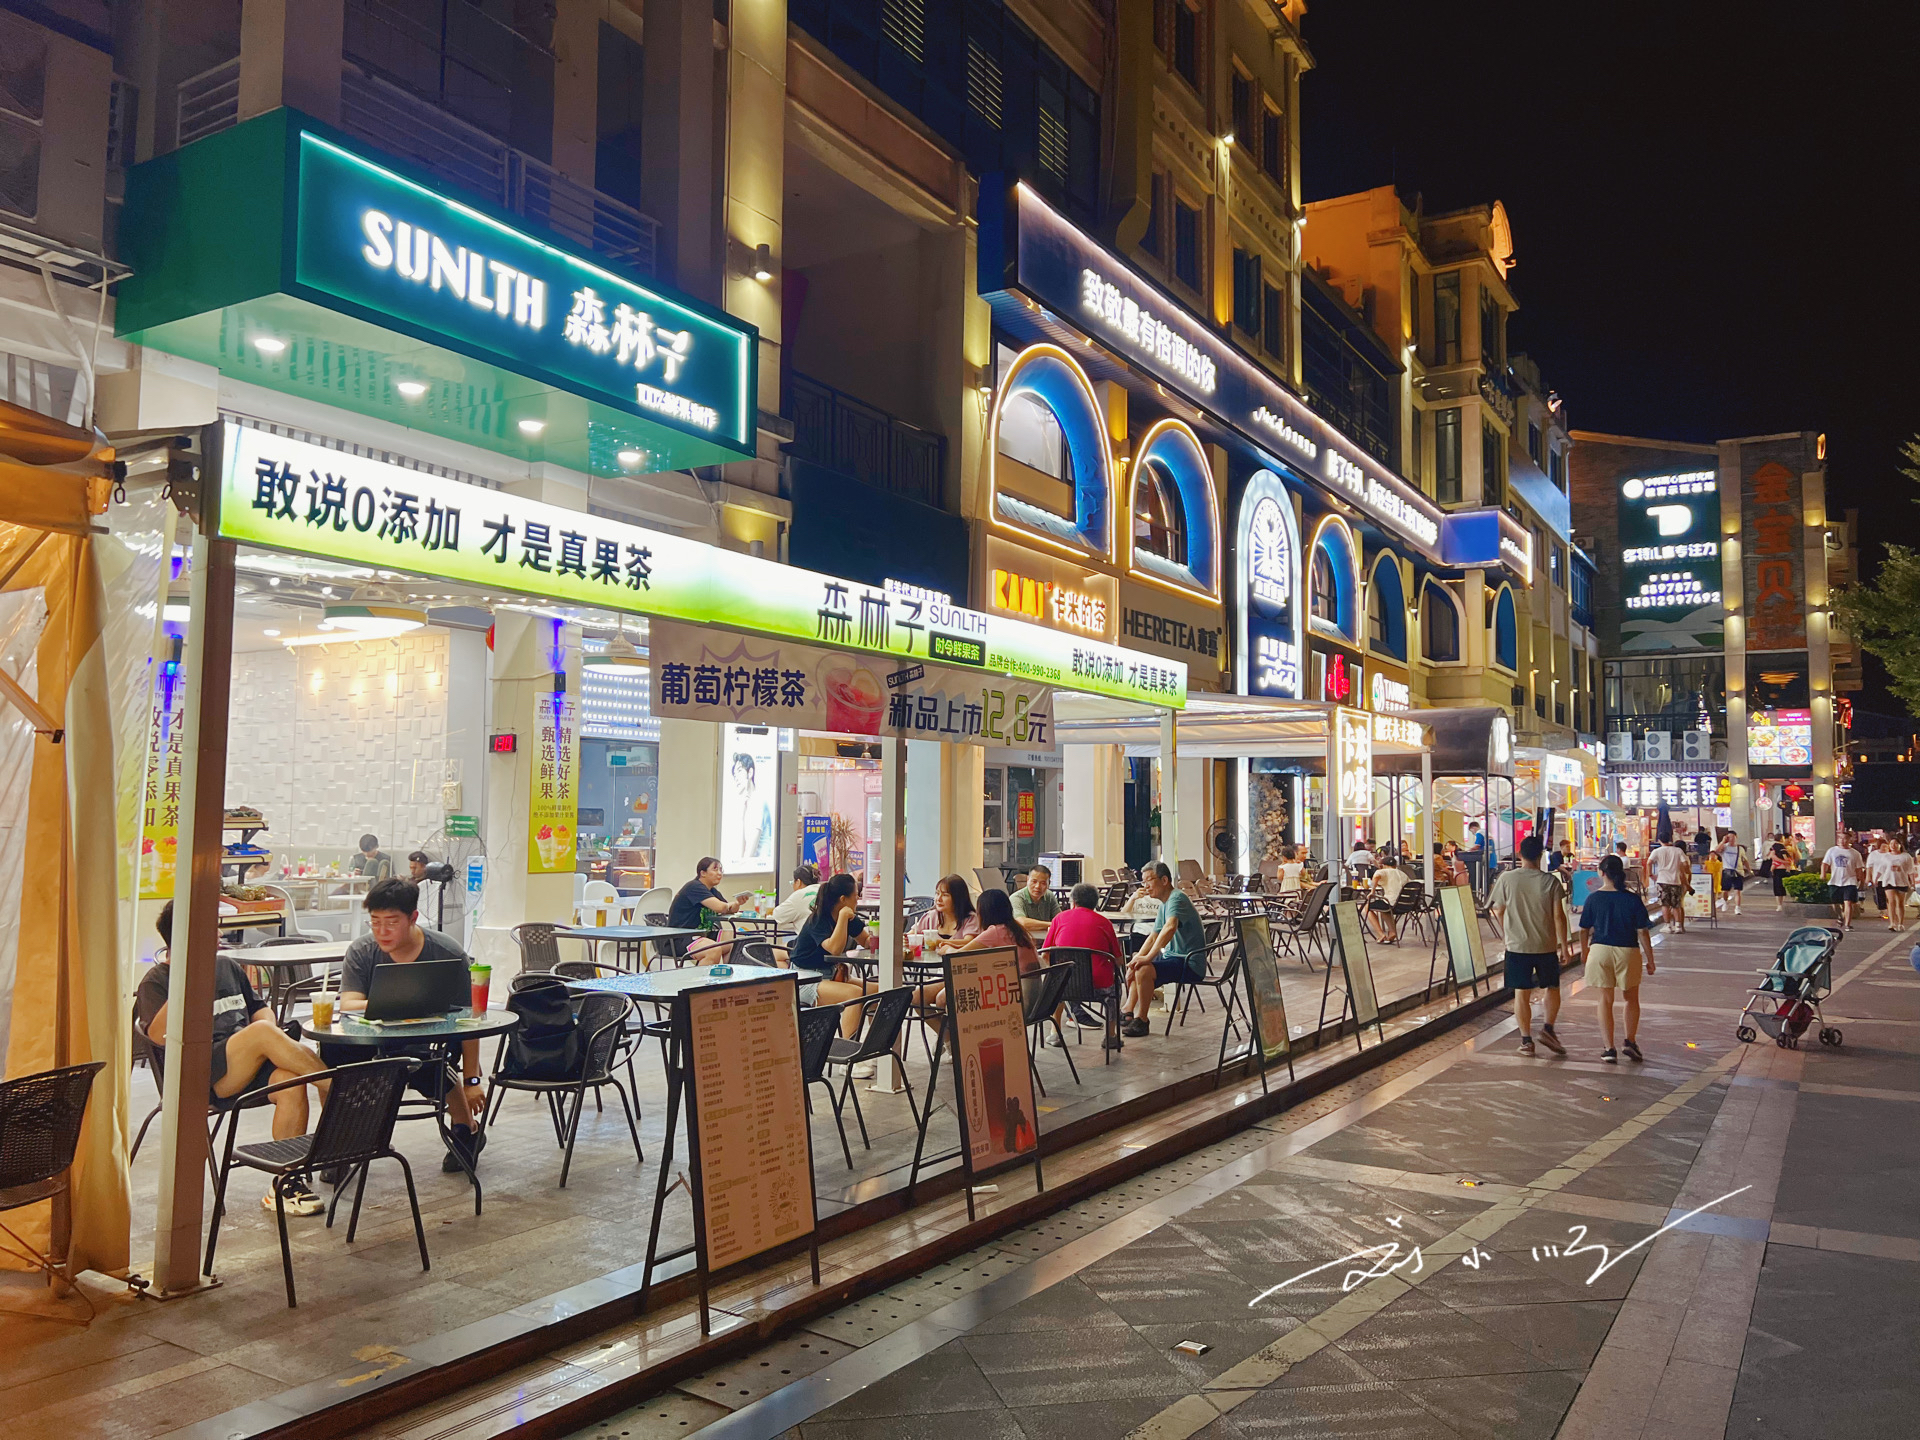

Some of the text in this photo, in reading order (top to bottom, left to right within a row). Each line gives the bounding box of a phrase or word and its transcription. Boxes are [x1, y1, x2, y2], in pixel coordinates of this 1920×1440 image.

[361, 208, 692, 384] SUNLTH 森林子
[251, 456, 654, 594] 敢说0添加 才是真果茶
[816, 581, 925, 654] 森林子
[992, 568, 1107, 633] KAMI 卡米的茶
[1640, 580, 1702, 596] 8897878
[934, 637, 981, 661] 时令鲜果茶
[1123, 606, 1197, 652] HEERETEA
[660, 661, 806, 708] 葡萄柠檬茶
[1072, 648, 1178, 697] 敢说0添加 才是真果茶
[888, 687, 1048, 746] 新品上市12.8元
[162, 707, 185, 828] 才是真果茶
[540, 726, 556, 800] 甄选鲜果
[556, 726, 572, 800] 精选好茶
